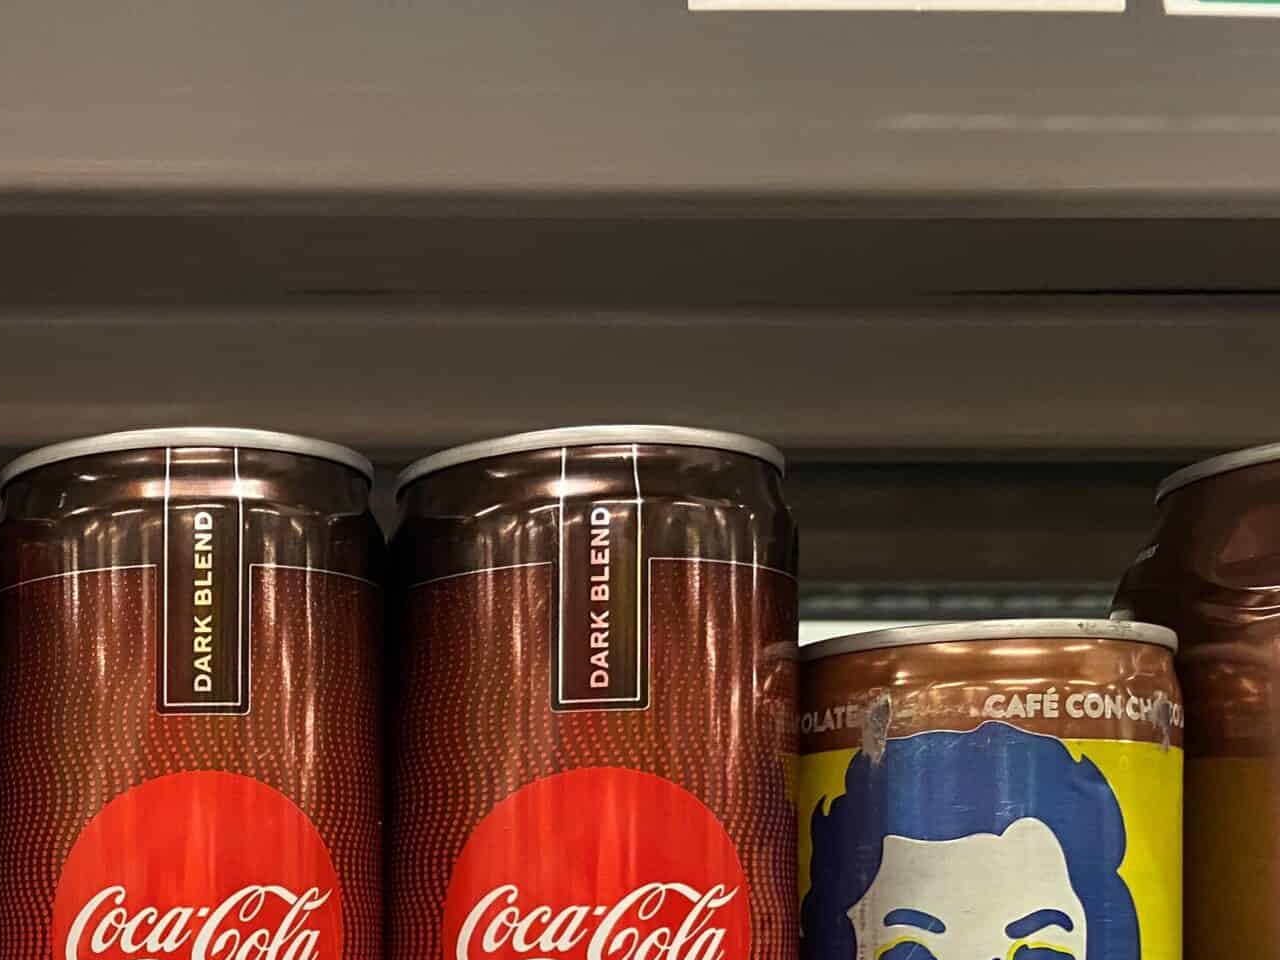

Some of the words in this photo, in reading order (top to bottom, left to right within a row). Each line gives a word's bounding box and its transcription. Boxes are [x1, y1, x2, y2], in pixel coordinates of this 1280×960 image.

[193, 510, 214, 608] BLEND
[590, 506, 612, 607] BLEND
[193, 627, 213, 694] DARK
[590, 626, 610, 690] DARK
[983, 687, 1059, 719] CAFÉ
[1065, 693, 1122, 719] CON
